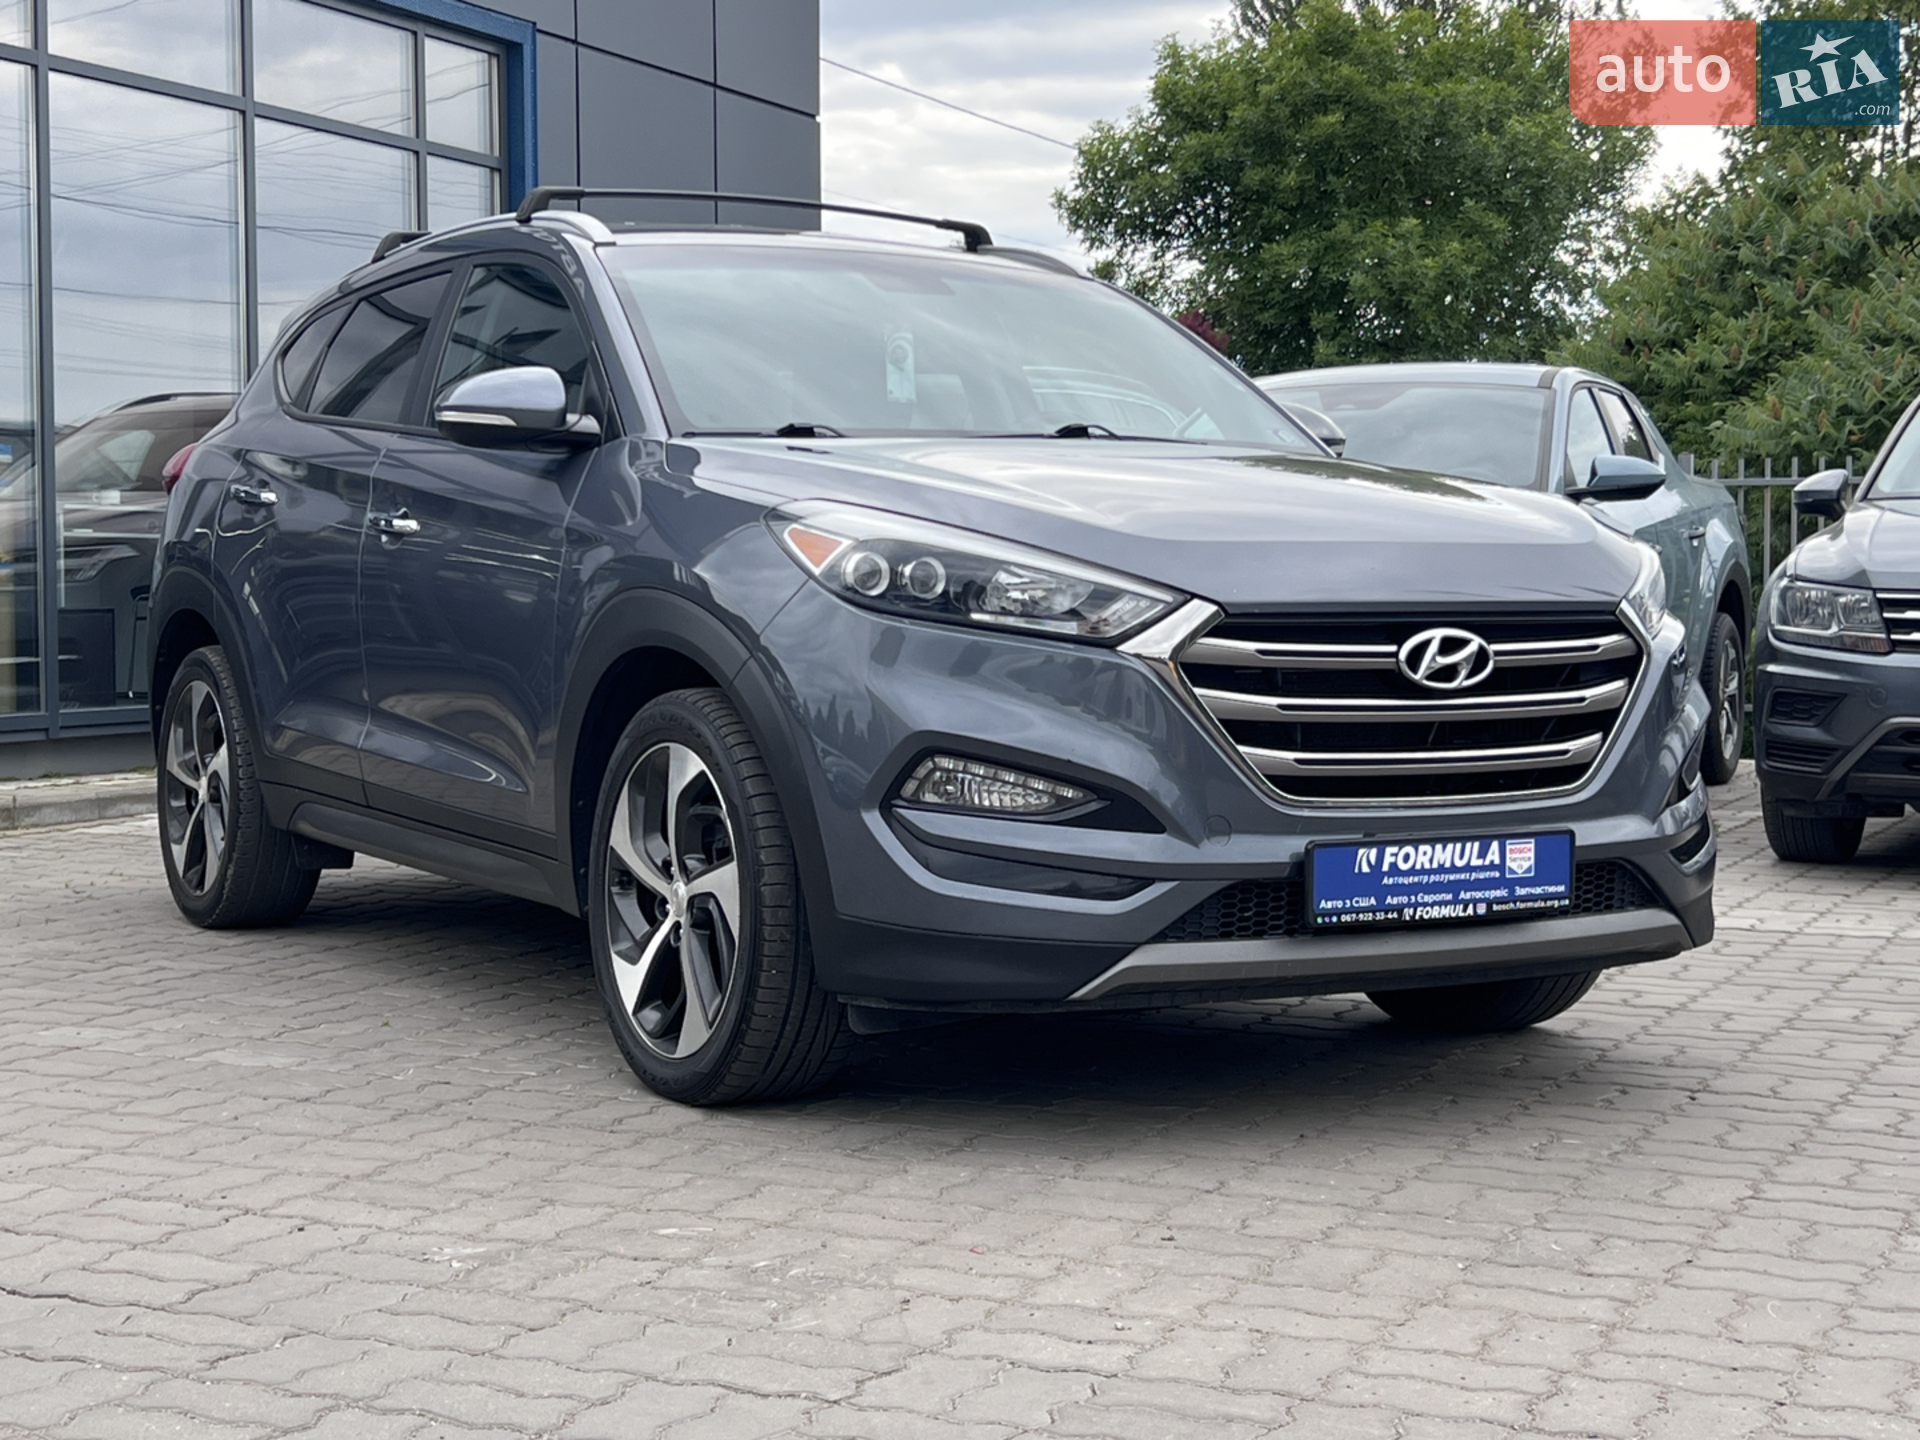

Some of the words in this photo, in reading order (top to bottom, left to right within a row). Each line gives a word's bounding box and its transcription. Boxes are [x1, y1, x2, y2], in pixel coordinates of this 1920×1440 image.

[1381, 840, 1500, 872] FORMULA
[1509, 846, 1532, 855] BOSCH
[1381, 873, 1429, 885] Автоцентр
[1429, 871, 1470, 884] розумних
[1470, 869, 1500, 881] рішень
[1319, 899, 1343, 909] Авто
[1344, 899, 1351, 908] з
[1352, 896, 1377, 907] США
[1385, 894, 1409, 905] Авто
[1409, 895, 1416, 904] з
[1416, 891, 1453, 905] Європи
[1458, 886, 1509, 900] Автосервіс
[1514, 884, 1565, 896] Запчастини
[1340, 911, 1398, 922] 067-922-33-44
[1415, 903, 1474, 920] FORMULA
